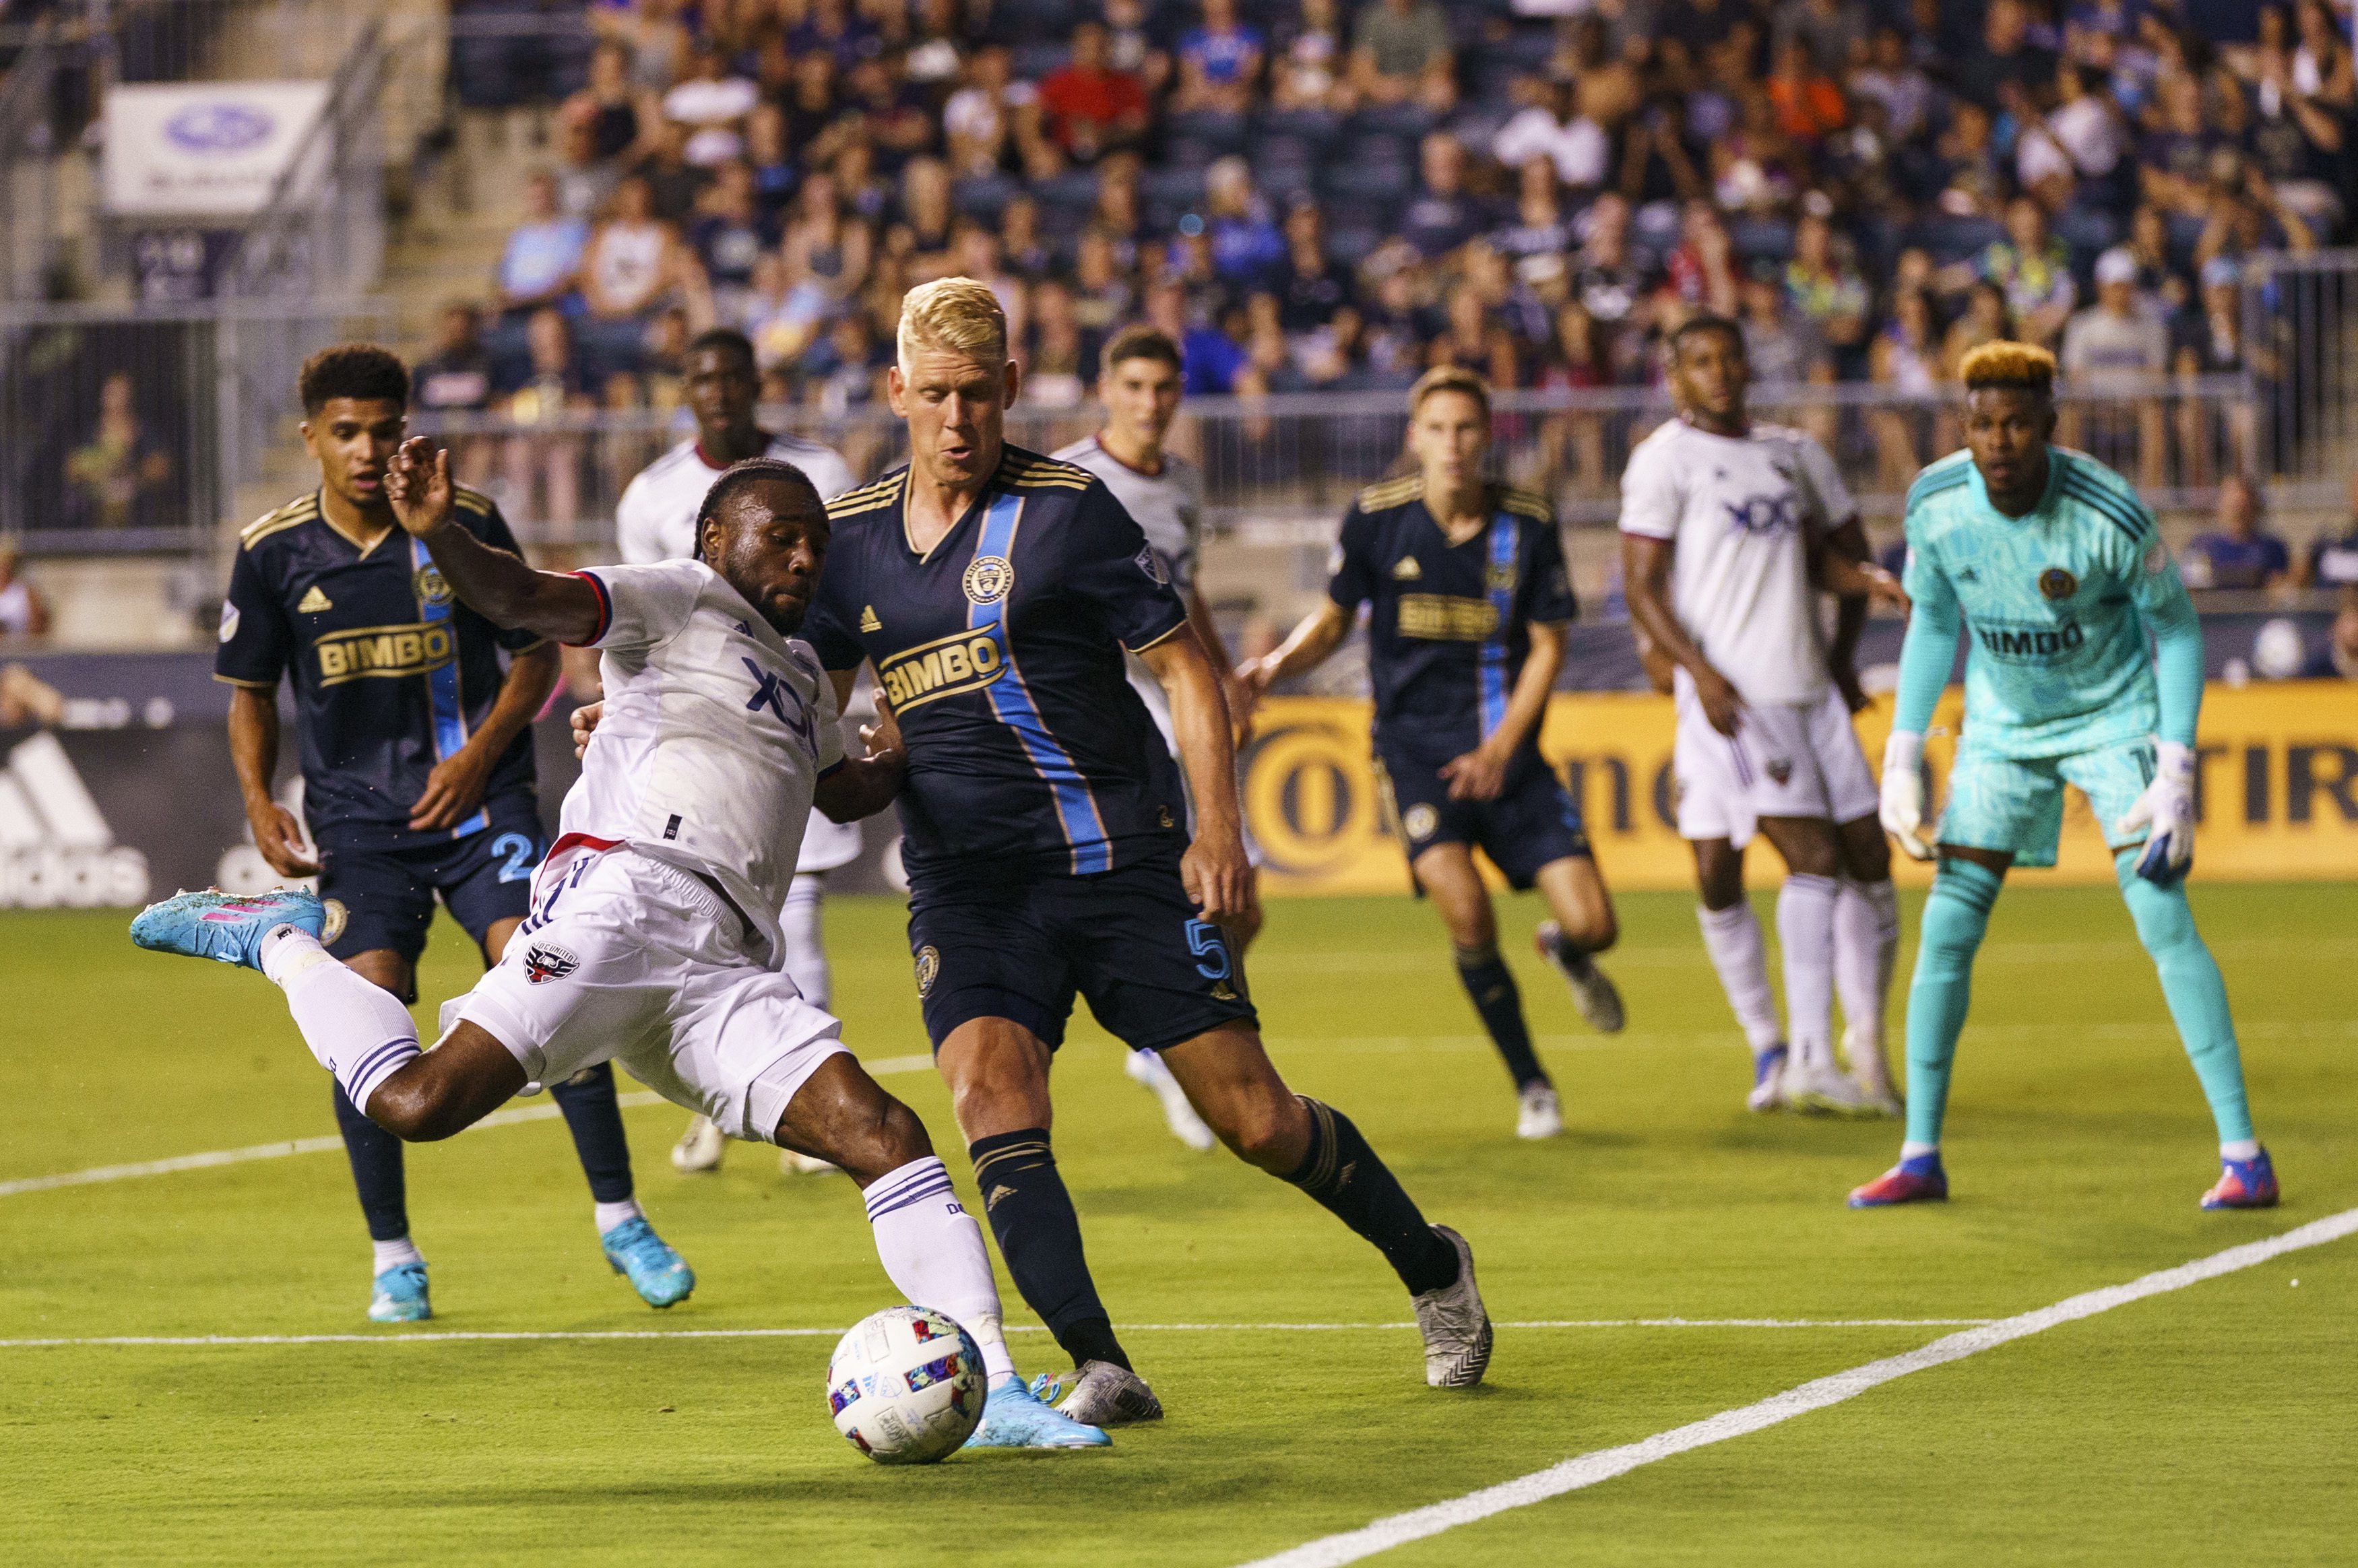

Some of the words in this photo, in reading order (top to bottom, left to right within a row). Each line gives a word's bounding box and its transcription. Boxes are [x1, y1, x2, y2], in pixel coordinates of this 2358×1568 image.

[319, 628, 450, 677] BIMBO
[882, 636, 1000, 707] BIMBO
[491, 831, 547, 884] 2
[1184, 917, 1232, 979] 5
